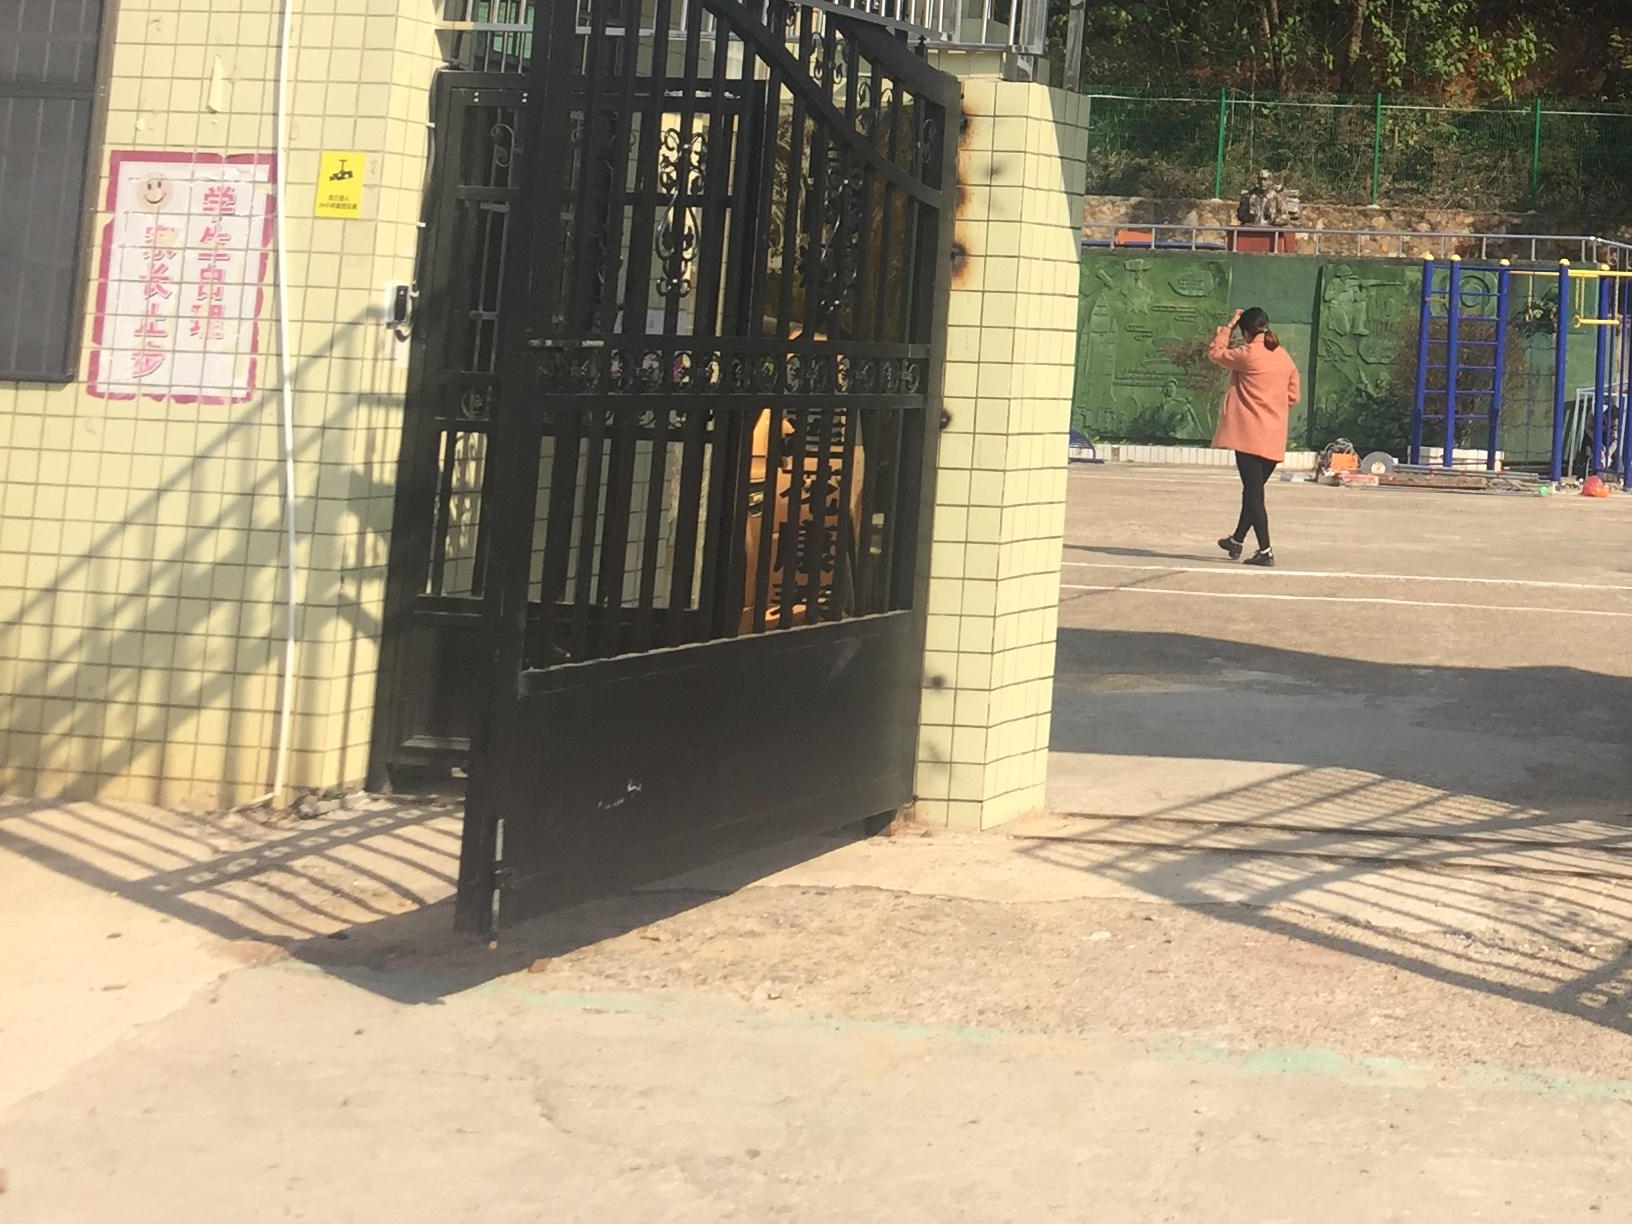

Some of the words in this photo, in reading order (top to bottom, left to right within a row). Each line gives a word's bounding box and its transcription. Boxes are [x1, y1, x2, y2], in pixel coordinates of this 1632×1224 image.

[131, 223, 177, 379] 家长止步
[189, 184, 237, 339] 学生自理
